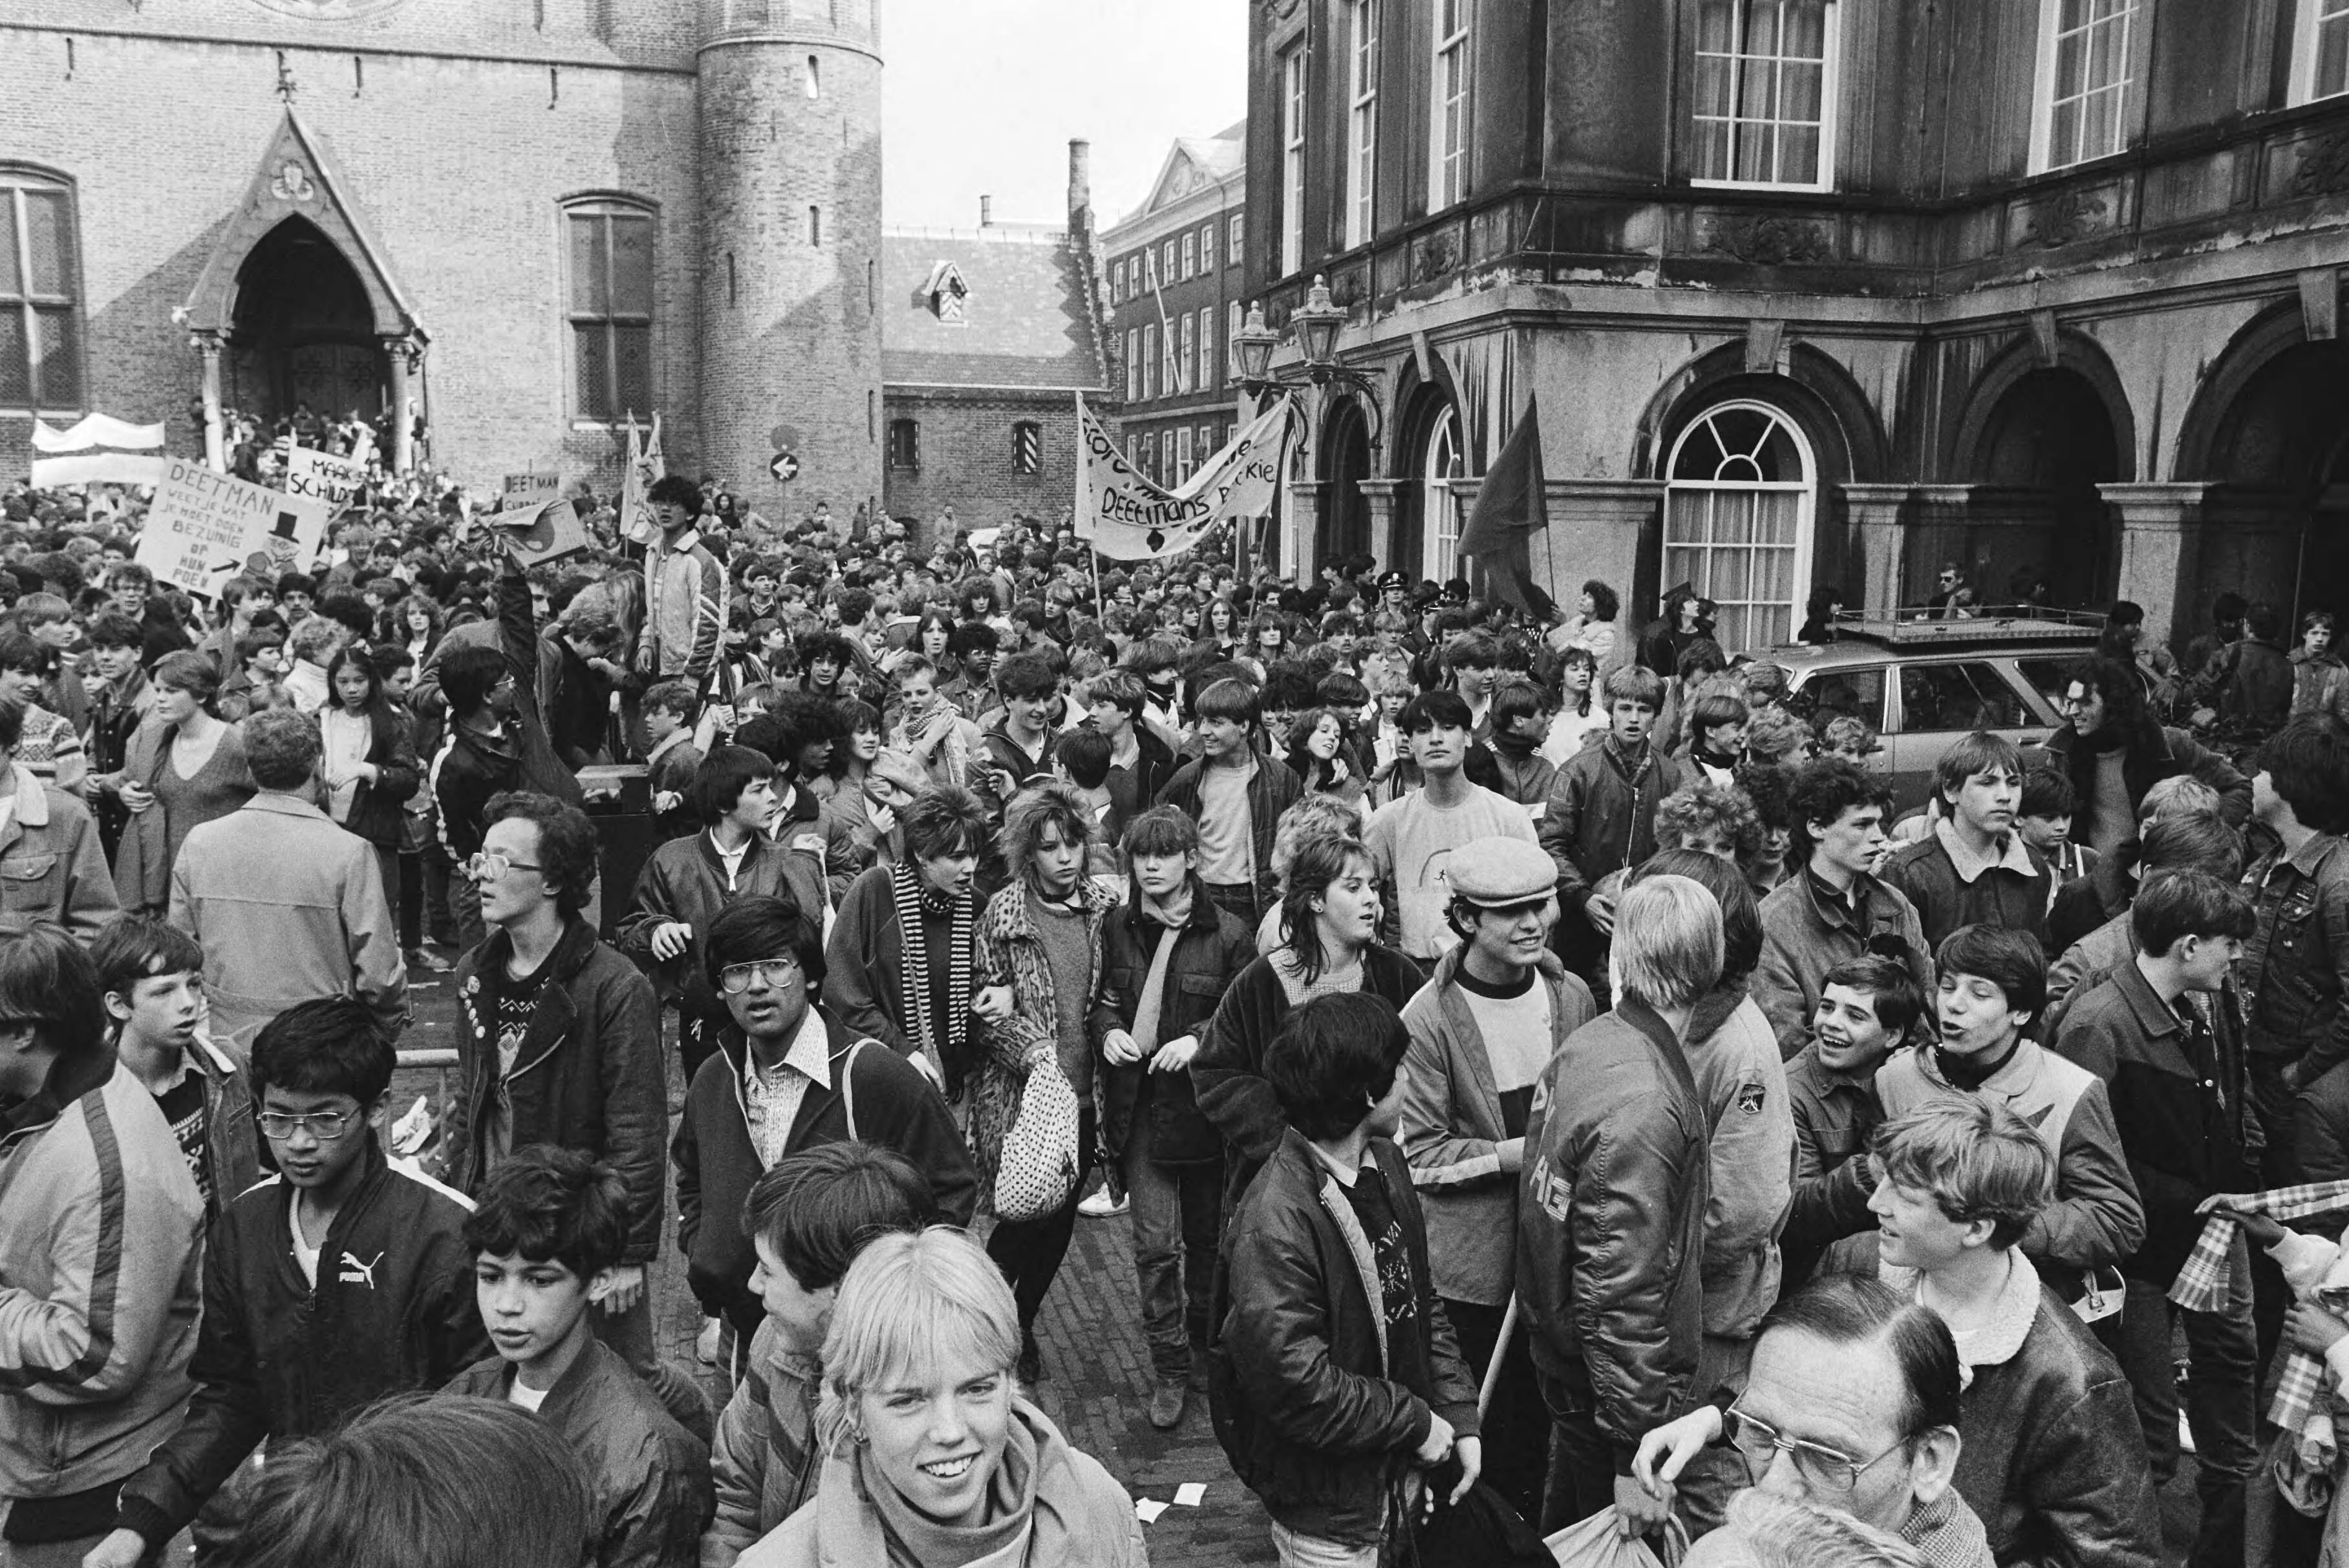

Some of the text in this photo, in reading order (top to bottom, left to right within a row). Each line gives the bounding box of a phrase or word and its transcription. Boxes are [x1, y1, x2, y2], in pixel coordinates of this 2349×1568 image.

[169, 464, 274, 515] DEETMAN
[505, 475, 559, 493] DEETMAN
[191, 542, 209, 555] OP
